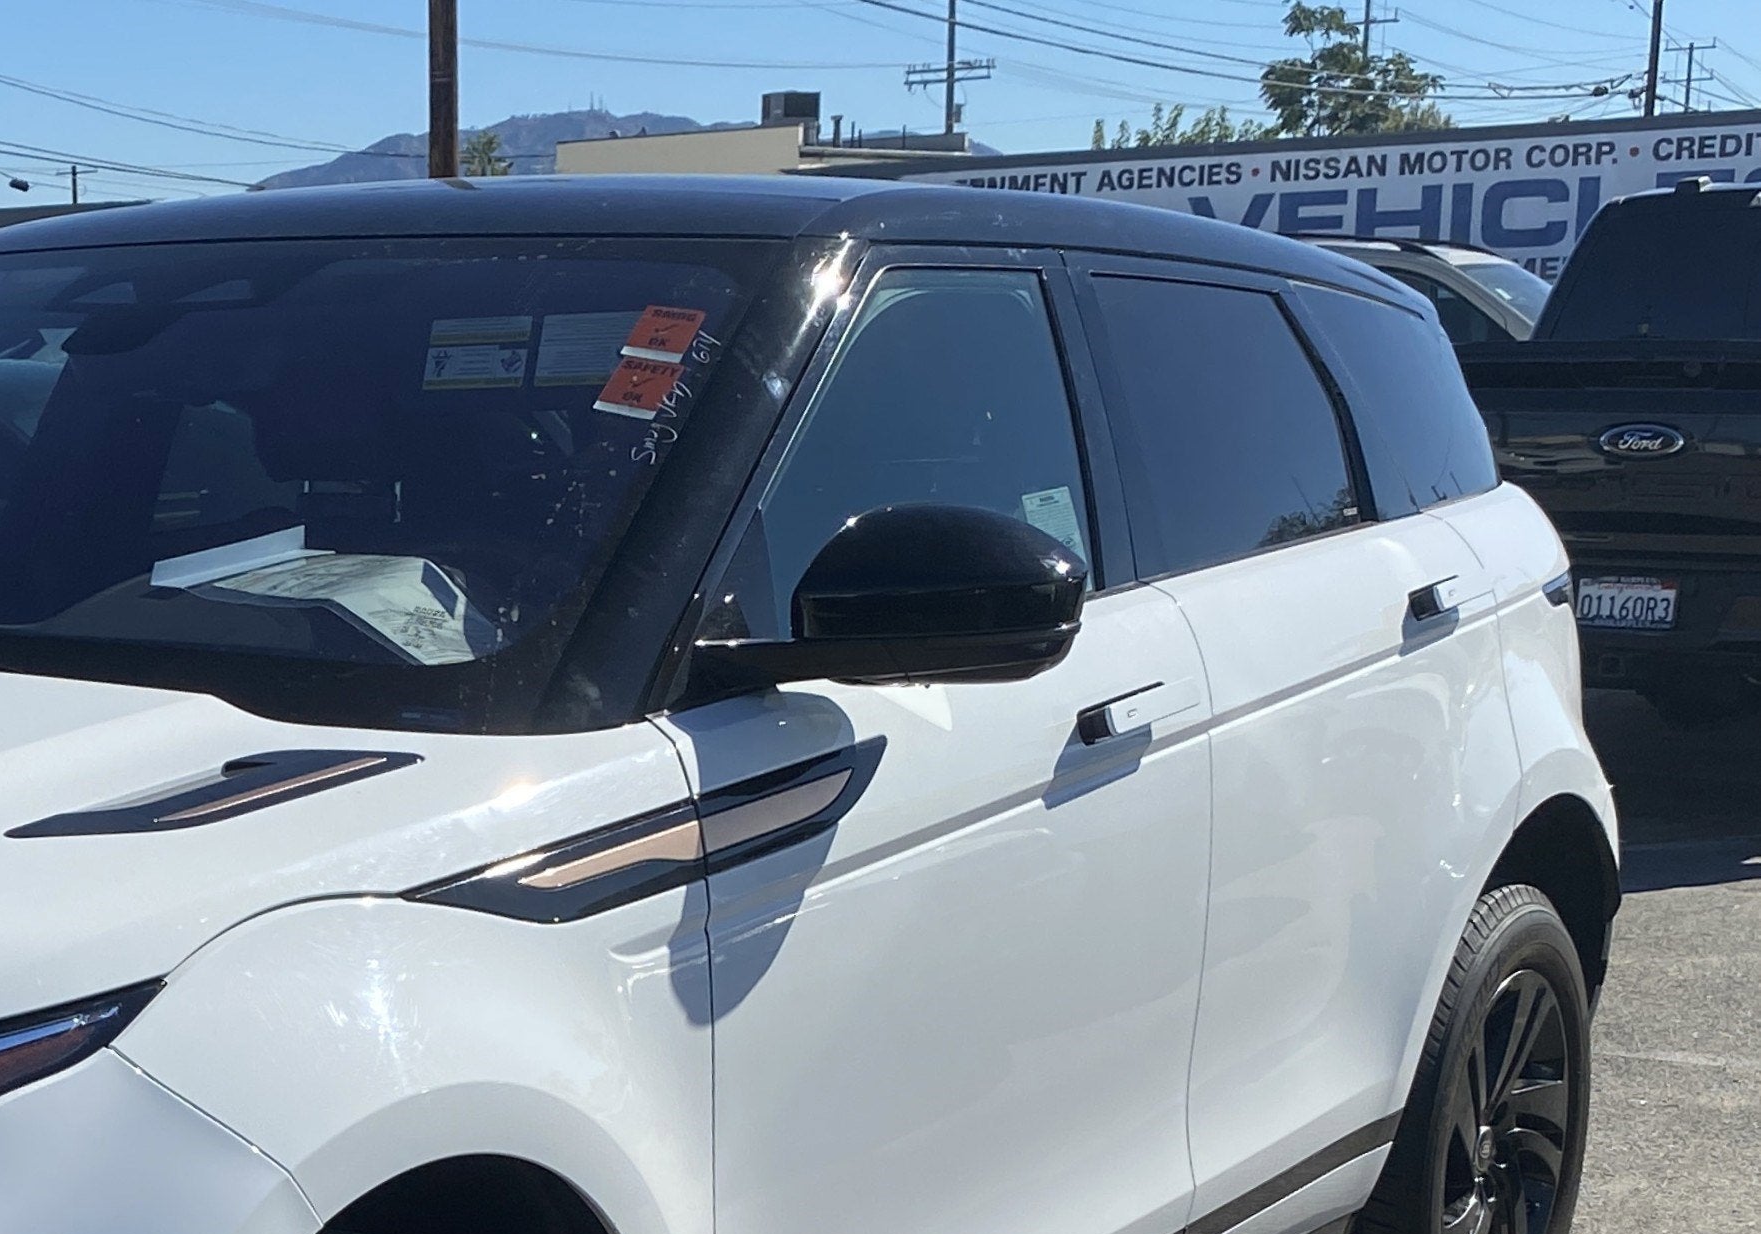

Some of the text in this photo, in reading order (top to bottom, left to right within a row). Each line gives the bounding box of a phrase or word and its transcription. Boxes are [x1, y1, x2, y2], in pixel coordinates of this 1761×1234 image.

[1096, 162, 1243, 193] AGENCIES
[1269, 153, 1387, 183] NISSAN
[1398, 147, 1512, 176] MOTOR
[1525, 141, 1618, 168] CORP.
[621, 359, 679, 378] SAFETY
[1618, 430, 1664, 450] Ford
